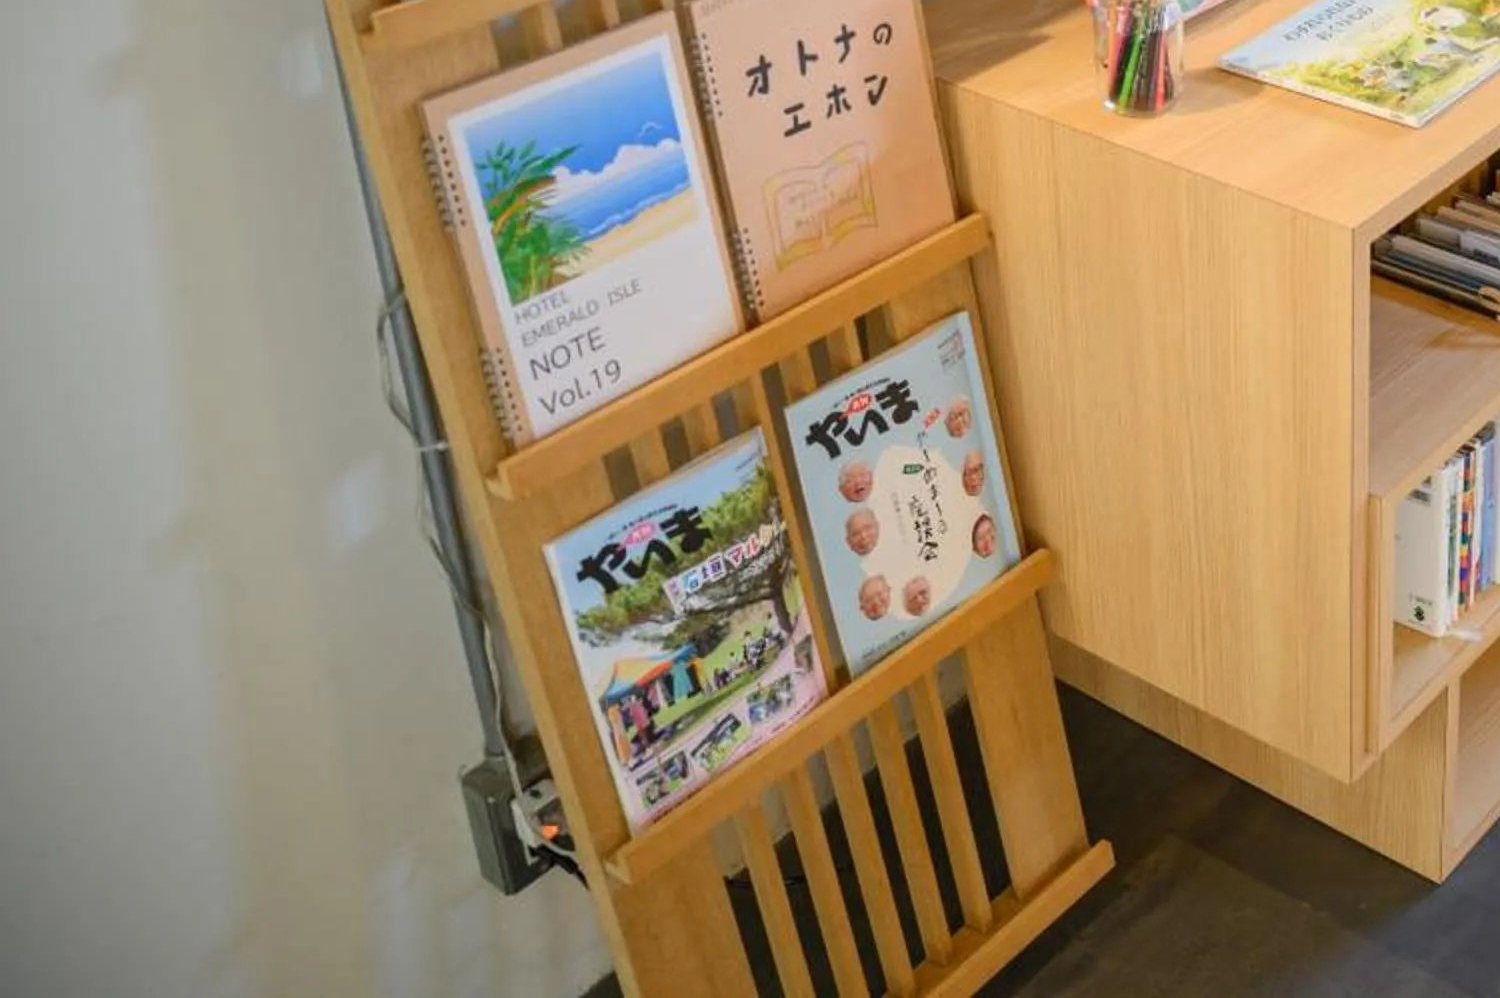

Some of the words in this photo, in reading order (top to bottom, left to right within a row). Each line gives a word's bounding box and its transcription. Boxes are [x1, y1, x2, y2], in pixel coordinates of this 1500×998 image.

[745, 23, 893, 97] オトナの
[784, 74, 888, 138] エホン
[513, 291, 569, 325] HOTEL
[521, 303, 600, 349] EMERALD
[607, 278, 643, 309] ISLE
[529, 327, 606, 382] NOTE
[538, 359, 623, 417] Vol.19
[805, 379, 920, 460] やいま
[576, 505, 714, 594] やいま
